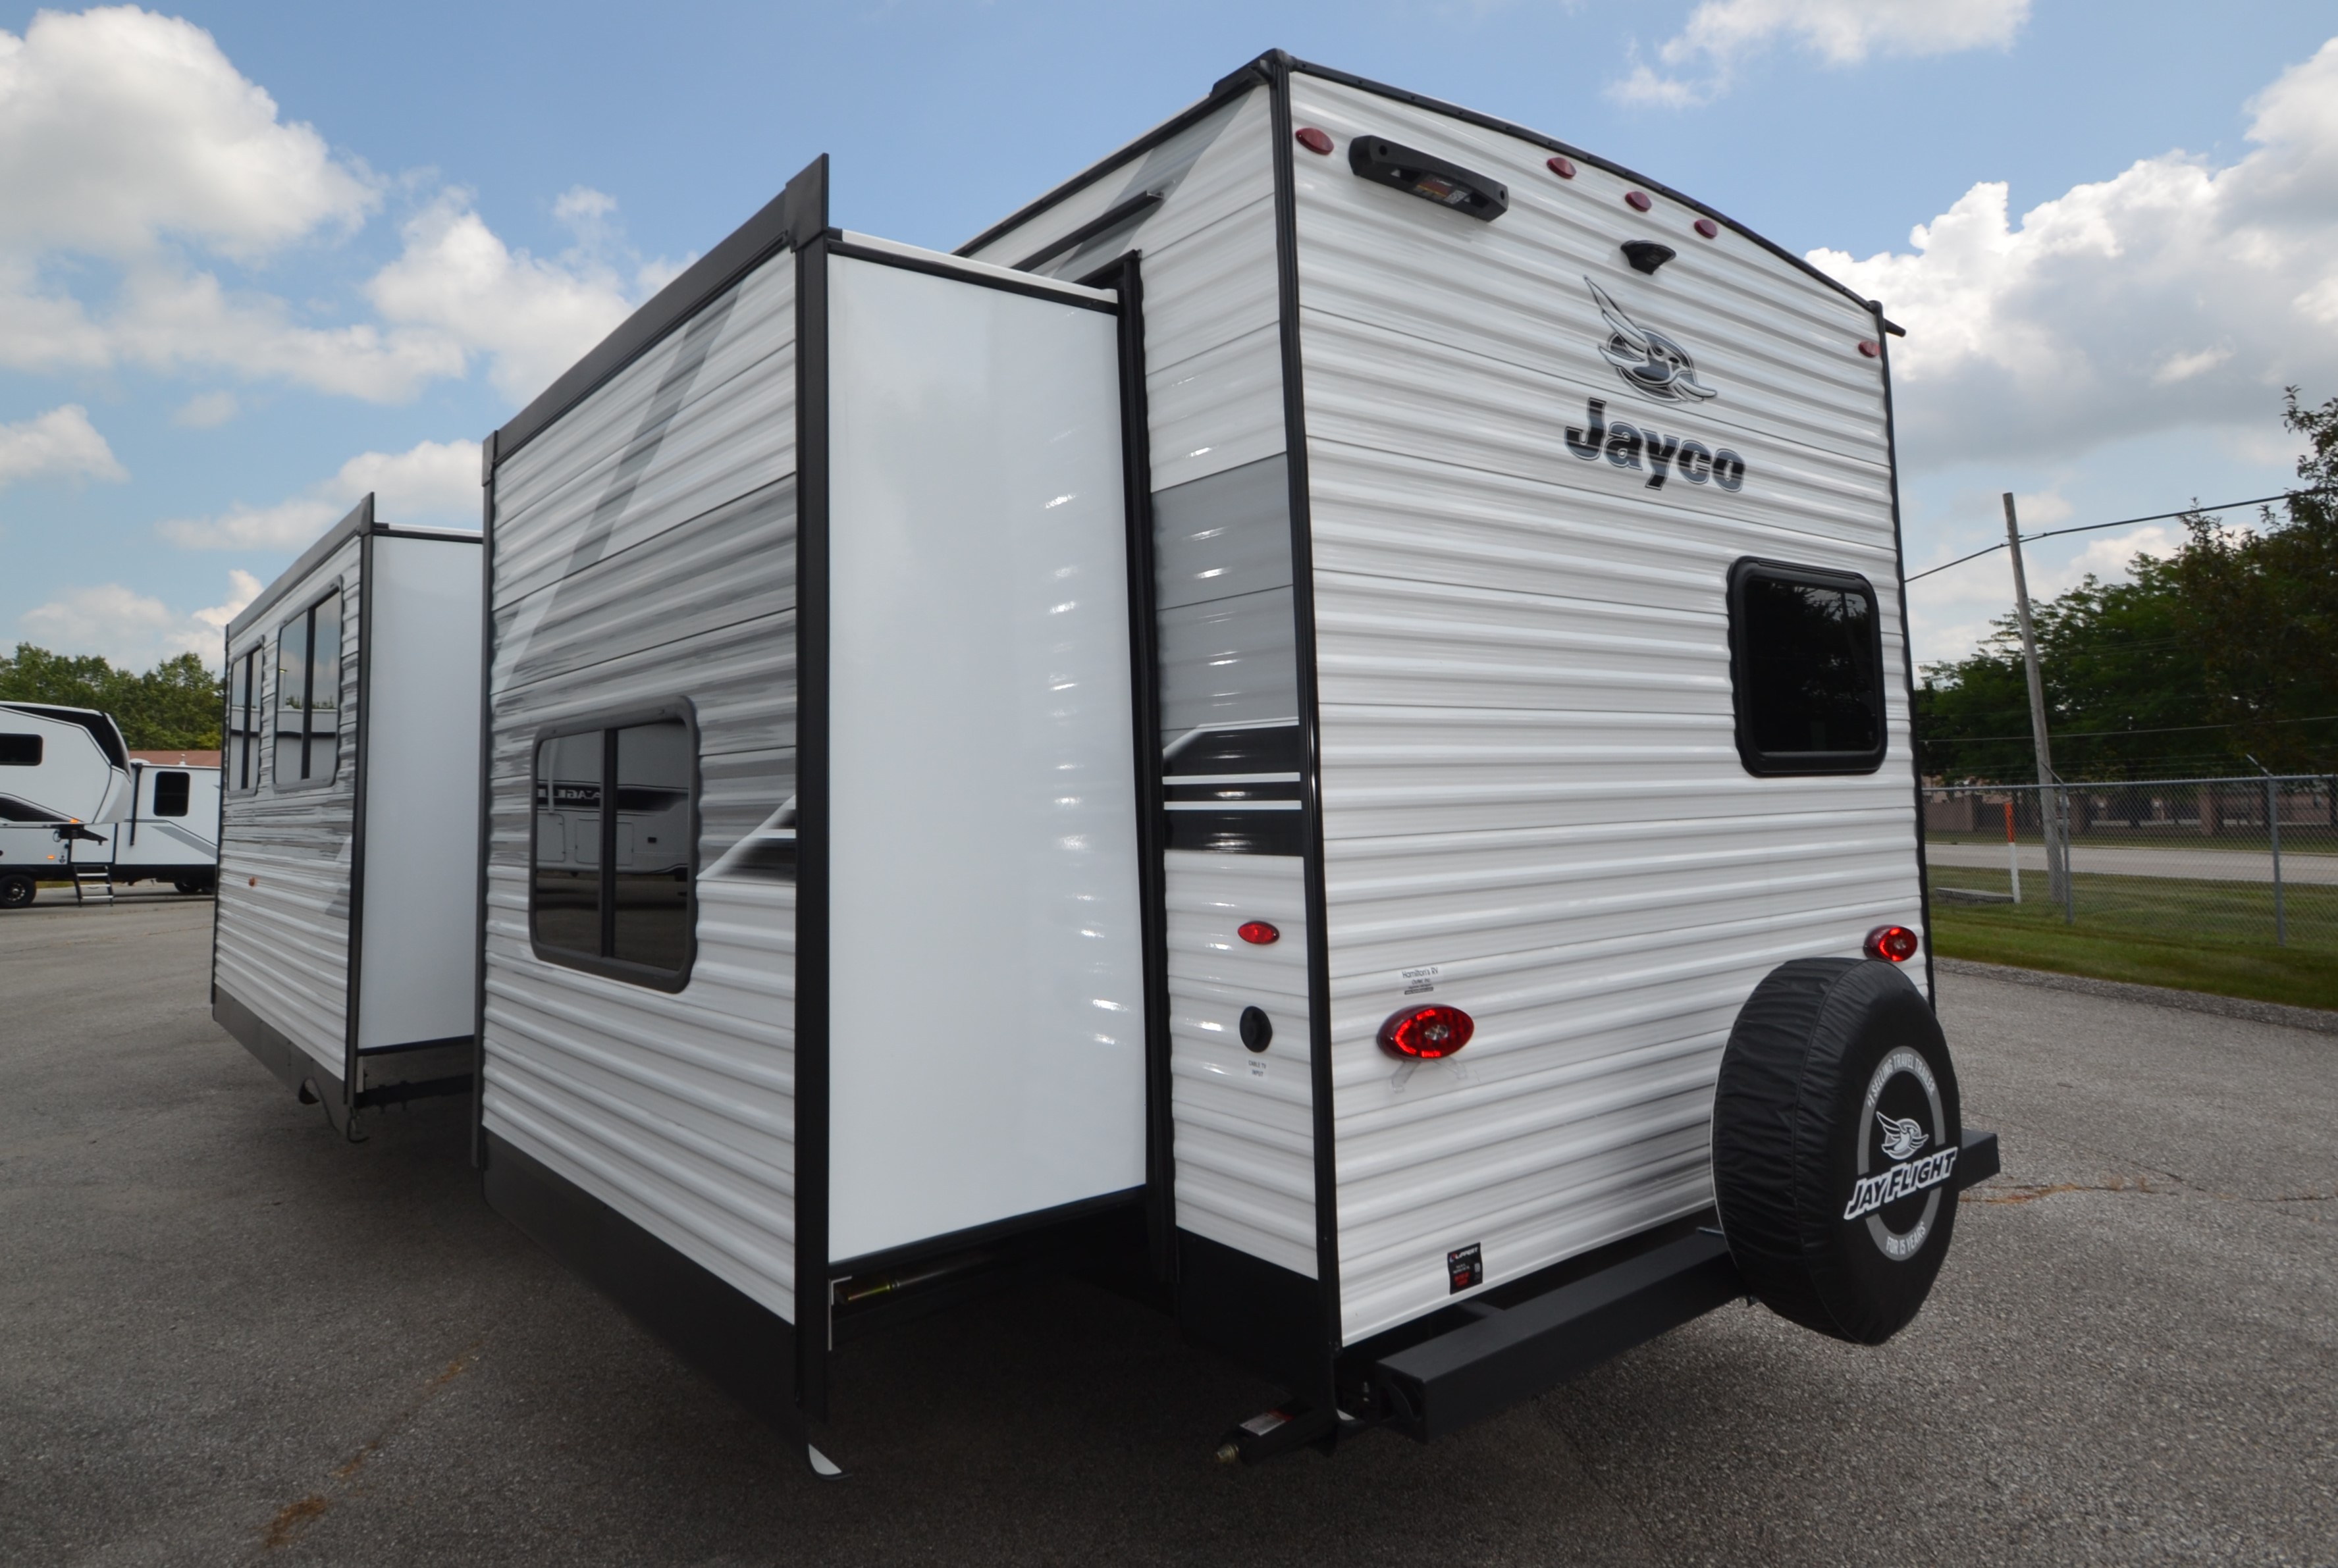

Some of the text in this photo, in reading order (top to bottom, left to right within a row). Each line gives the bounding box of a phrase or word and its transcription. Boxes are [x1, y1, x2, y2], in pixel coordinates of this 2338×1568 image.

[1564, 396, 1746, 493] Jayco
[1402, 969, 1430, 978] Hamilton's
[1871, 1058, 1894, 1097] SELLING
[1893, 1053, 1914, 1070] TRAVEL
[1915, 1057, 1936, 1096] TRAILER
[1886, 1221, 1926, 1255] FOR 15 YEARS
